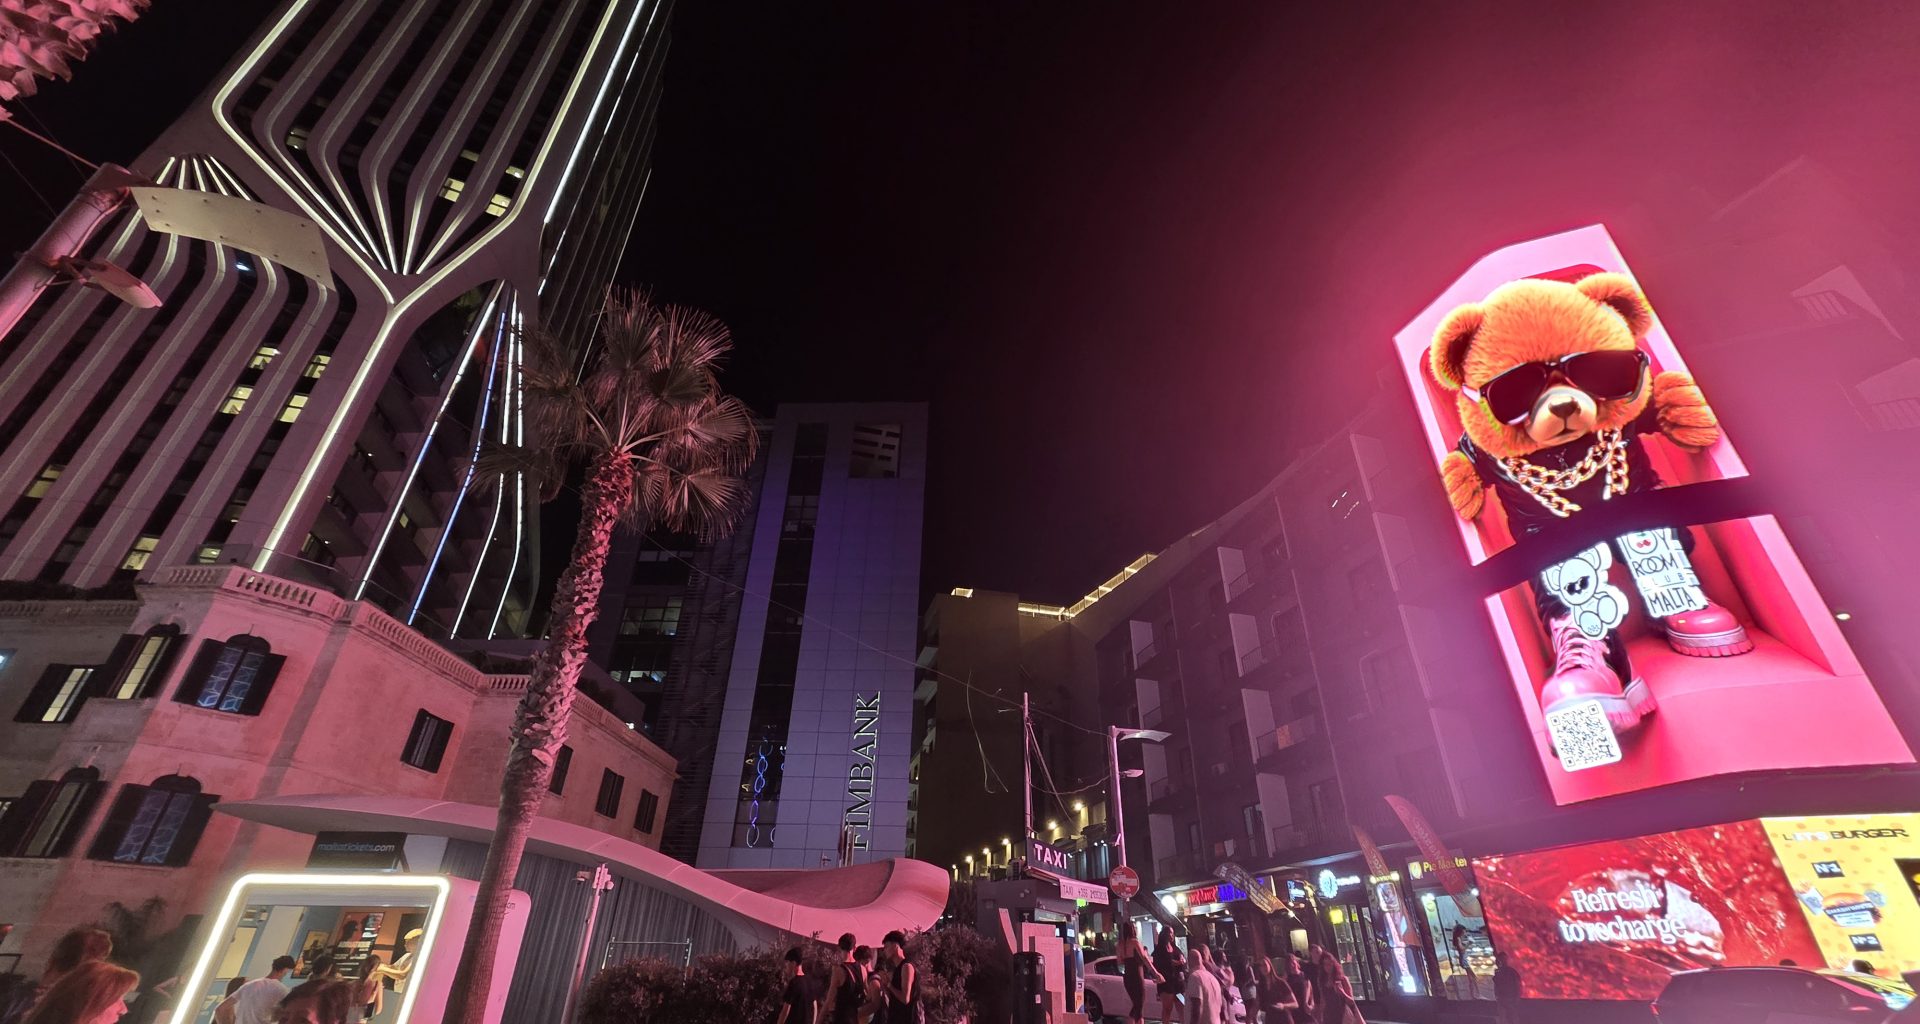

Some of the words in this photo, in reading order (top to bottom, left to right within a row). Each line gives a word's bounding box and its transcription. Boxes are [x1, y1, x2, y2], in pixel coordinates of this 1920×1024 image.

[1631, 552, 1679, 578] ROOM
[1647, 586, 1697, 614] MALTA
[844, 690, 881, 852] FIMBANK
[1829, 828, 1910, 840] BURGER
[1034, 843, 1067, 870] TAXI
[1423, 861, 1437, 873] Pie
[1438, 856, 1468, 870] Master
[1062, 884, 1074, 897] TAXI
[1571, 879, 1661, 913] Refresh
[1558, 919, 1586, 942] to
[1584, 915, 1687, 945] recharge
